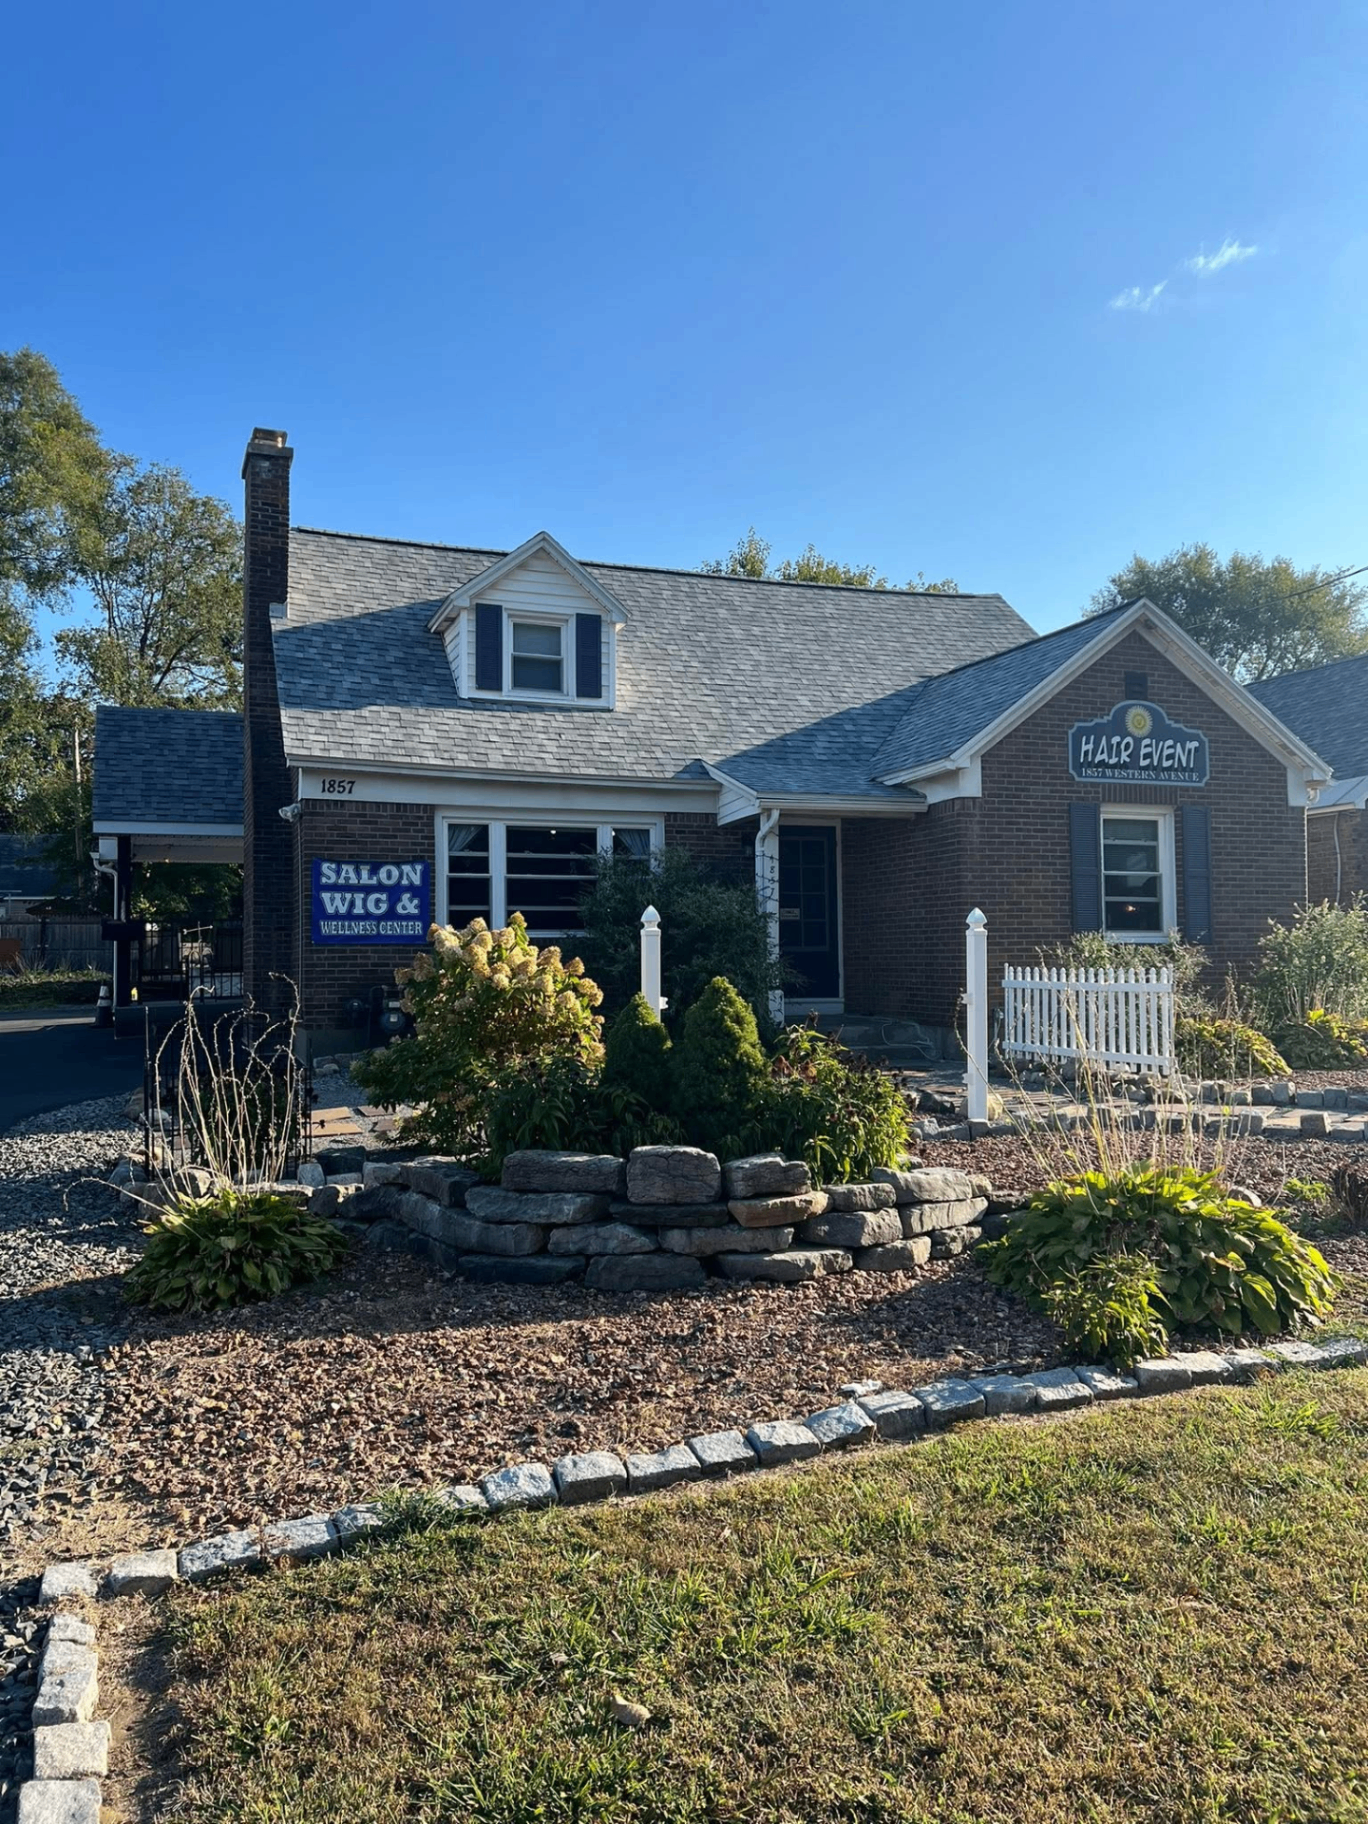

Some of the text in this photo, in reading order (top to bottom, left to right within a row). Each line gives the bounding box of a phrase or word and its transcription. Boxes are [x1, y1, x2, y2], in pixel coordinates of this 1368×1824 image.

[1080, 735, 1199, 768] HAIR EVENT
[1082, 768, 1199, 781] 1857 WESTERN AVENUE
[321, 779, 356, 794] 1857
[320, 862, 424, 886] SALON
[320, 892, 421, 915] WIG &
[320, 921, 424, 935] WELLNESS CENTER
